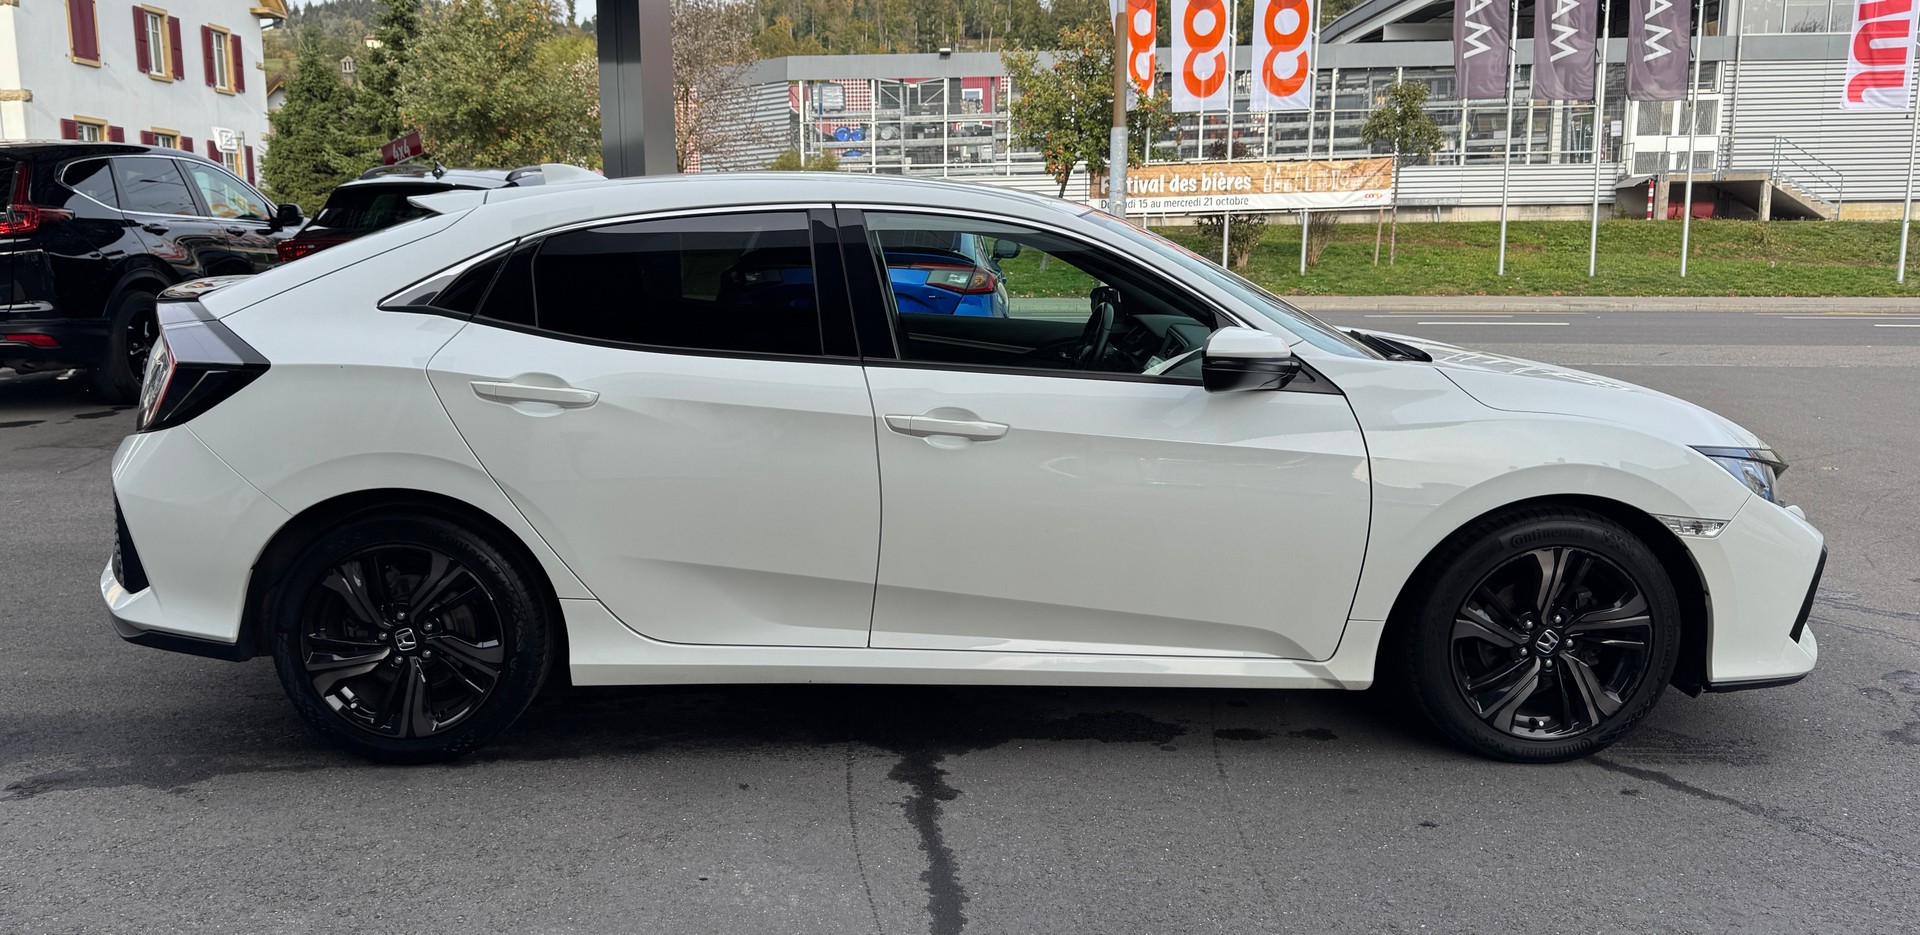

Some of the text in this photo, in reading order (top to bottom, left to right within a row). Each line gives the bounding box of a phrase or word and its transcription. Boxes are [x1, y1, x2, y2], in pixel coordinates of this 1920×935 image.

[392, 139, 411, 161] 4x4
[1100, 172, 1252, 194] Ftival des bières
[1139, 199, 1148, 208] 15
[1163, 198, 1201, 207] mercredi
[1203, 197, 1213, 206] 21
[1216, 196, 1249, 206] octobre
[1510, 528, 1585, 548] Continental
